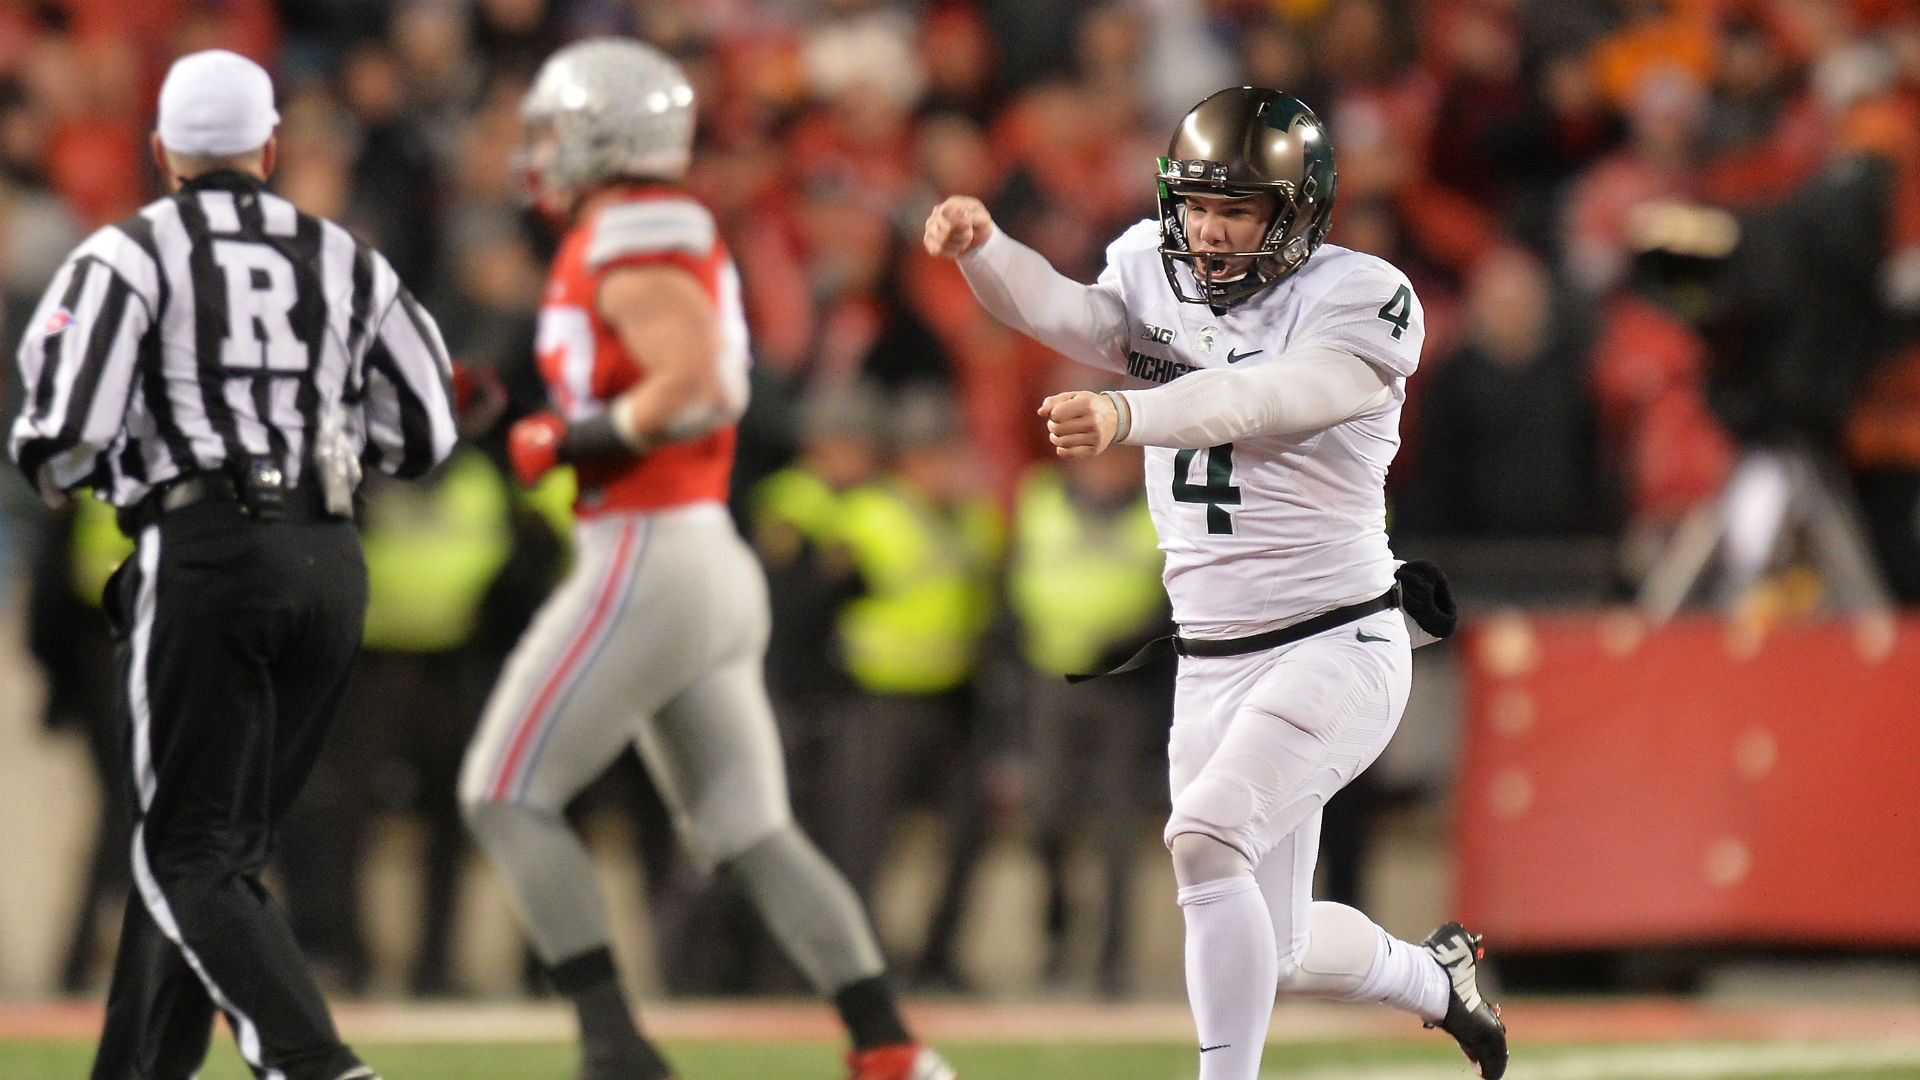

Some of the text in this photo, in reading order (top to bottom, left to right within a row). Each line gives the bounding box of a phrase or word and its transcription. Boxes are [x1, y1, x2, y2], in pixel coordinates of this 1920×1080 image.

[212, 239, 308, 371] R
[1377, 282, 1411, 341] 4
[1127, 350, 1206, 384] MICHIG
[1171, 442, 1242, 535] 4
